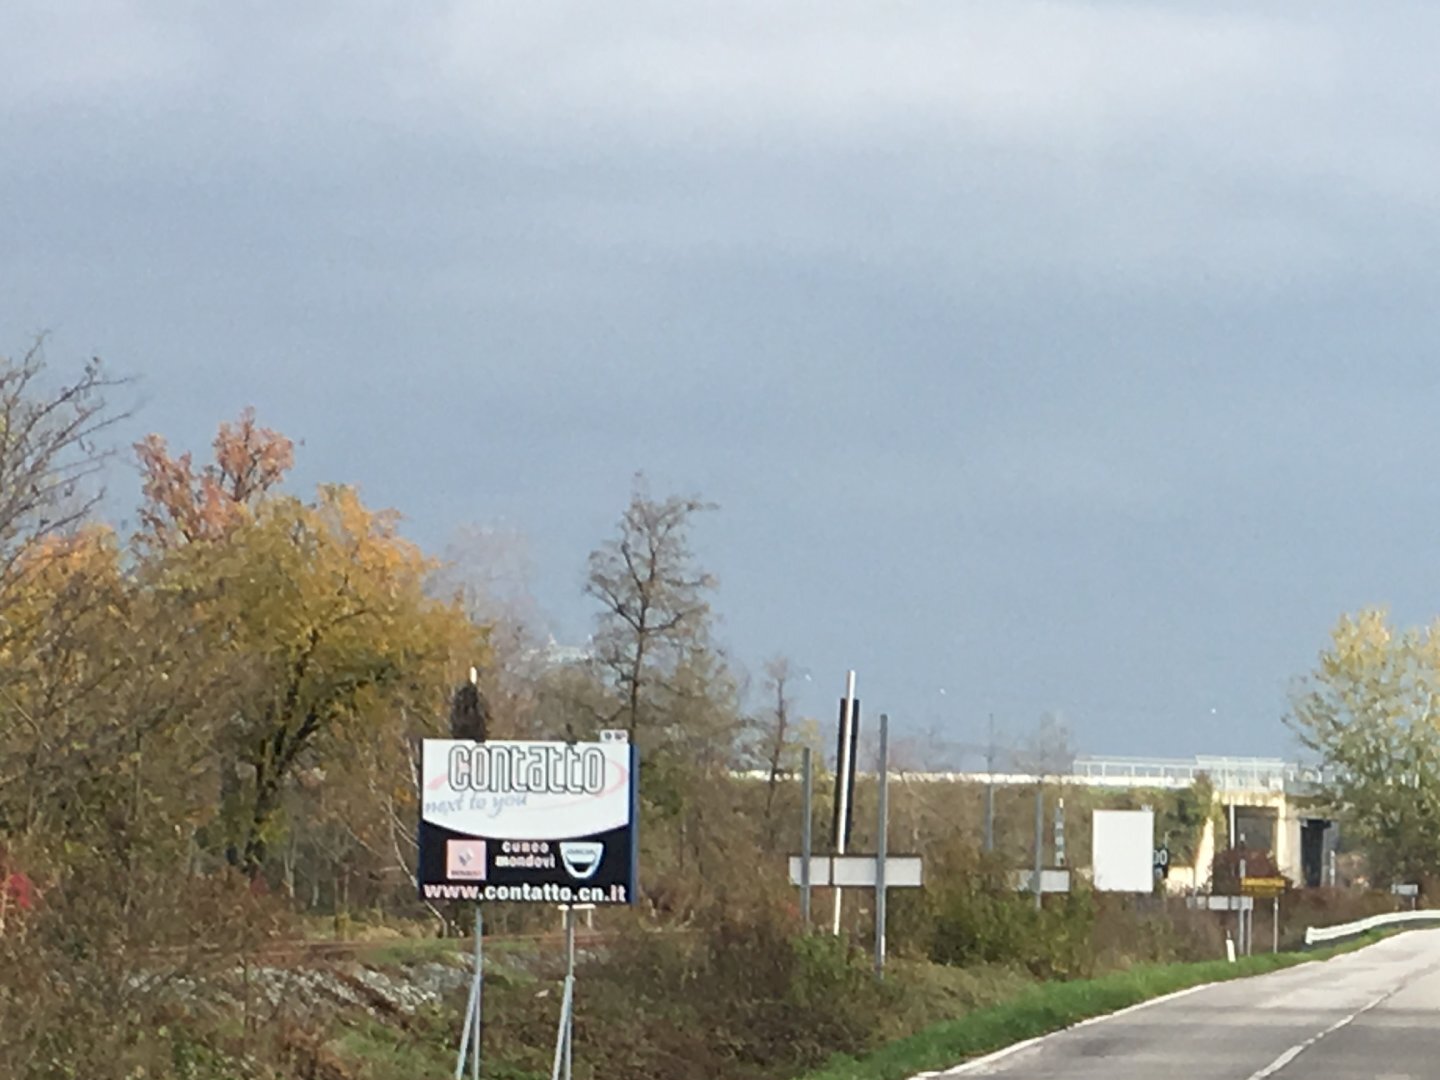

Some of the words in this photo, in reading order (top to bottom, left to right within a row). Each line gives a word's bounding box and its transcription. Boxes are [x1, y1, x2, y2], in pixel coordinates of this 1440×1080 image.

[425, 795, 464, 816] next
[469, 792, 487, 809] to
[493, 793, 528, 818] you
[424, 884, 626, 902] www.contatto.cn.it
